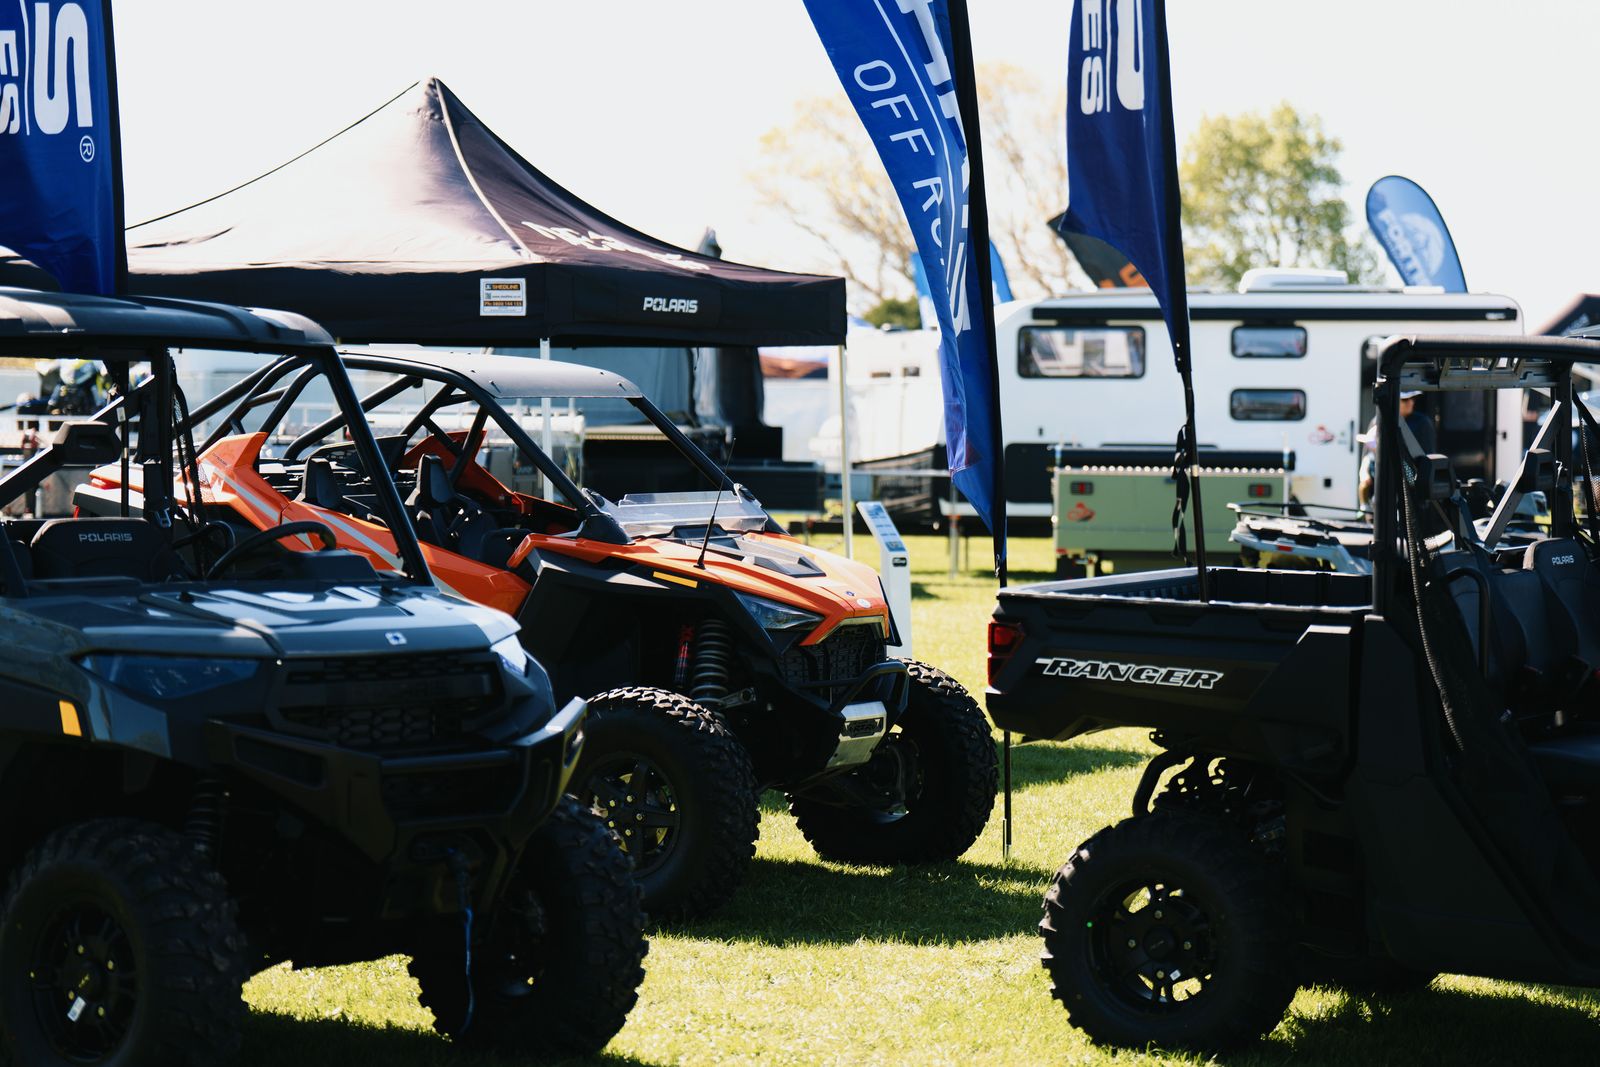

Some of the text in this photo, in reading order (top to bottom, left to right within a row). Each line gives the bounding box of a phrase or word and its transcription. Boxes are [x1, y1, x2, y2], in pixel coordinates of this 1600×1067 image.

[854, 60, 936, 156] OFF
[643, 297, 698, 314] POLARIS
[78, 532, 132, 542] POLARIS
[1552, 555, 1574, 566] POLARIS
[1036, 658, 1224, 689] RANGER
